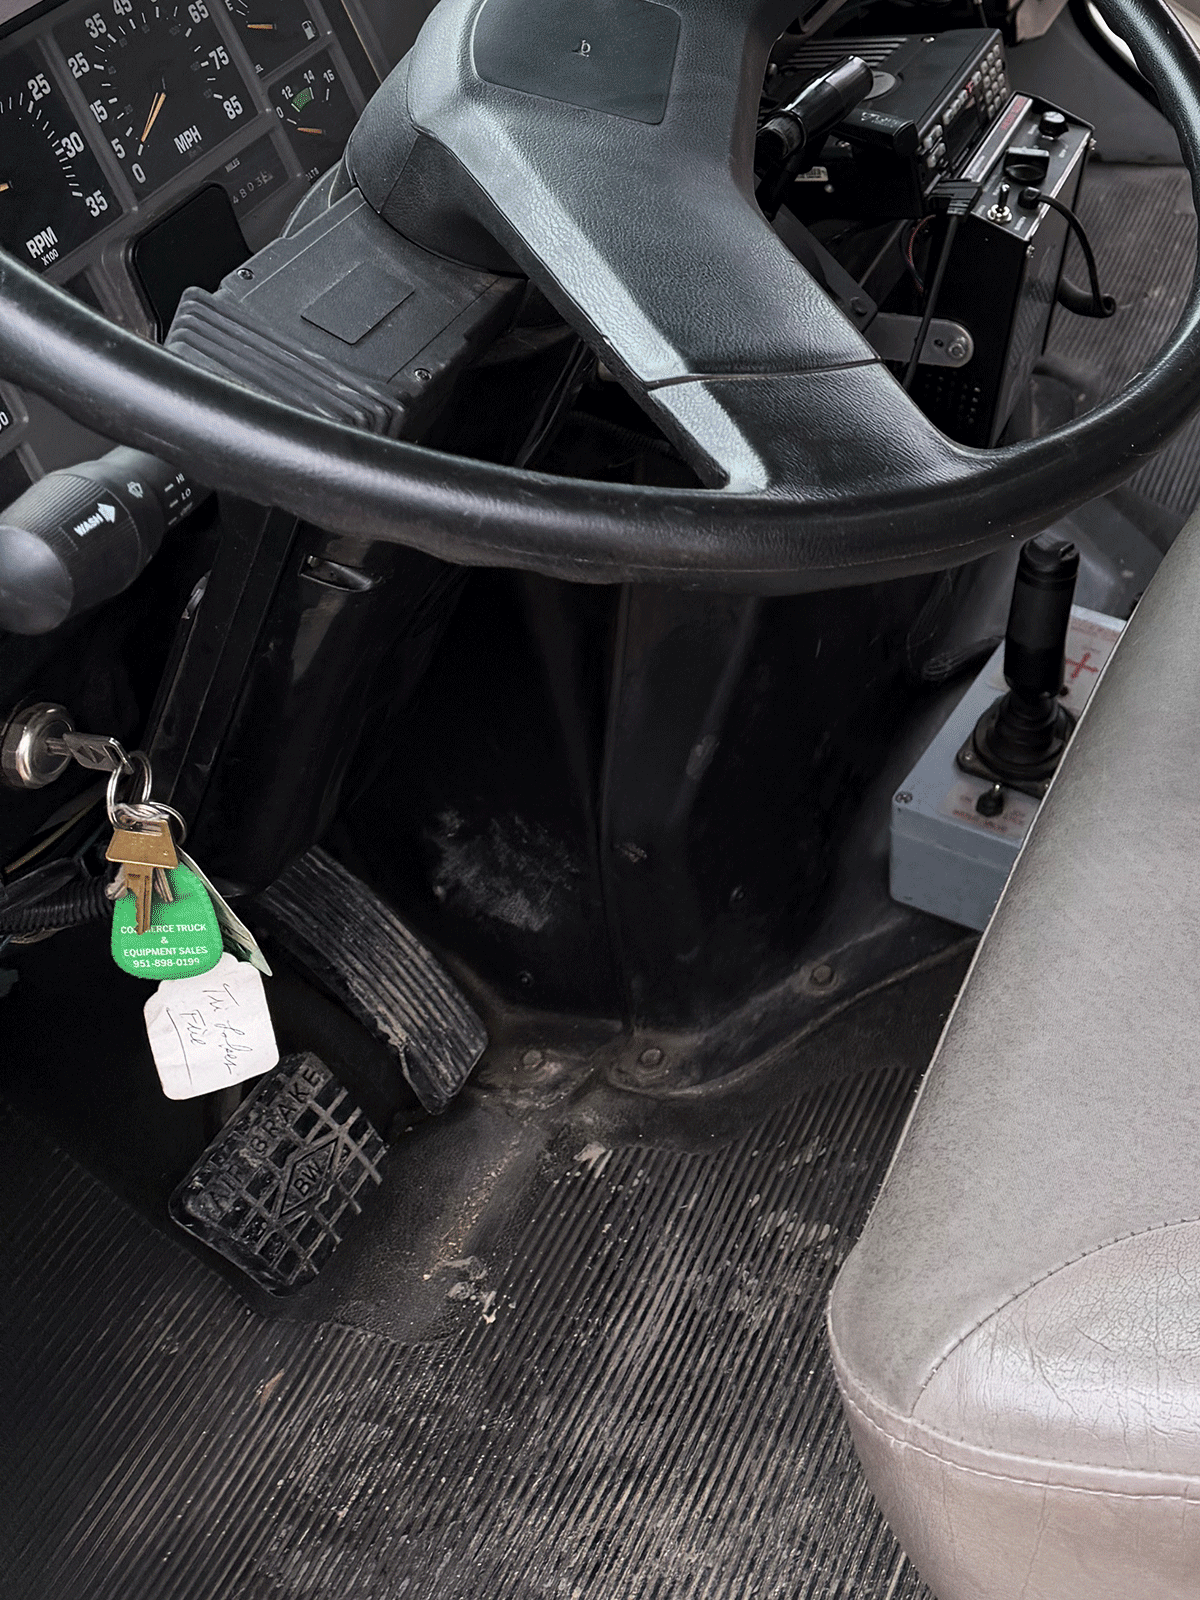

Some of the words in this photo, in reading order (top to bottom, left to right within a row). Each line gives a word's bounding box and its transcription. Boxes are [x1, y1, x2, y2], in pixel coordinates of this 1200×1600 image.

[187, 0, 209, 24] 65
[84, 12, 107, 39] 35
[67, 51, 90, 79] 25
[208, 45, 230, 70] 75
[27, 73, 52, 101] 25
[303, 69, 315, 84] 14
[322, 68, 335, 83] 16
[281, 85, 294, 100] 12
[89, 99, 108, 123] 15
[222, 95, 243, 120] 85
[275, 106, 285, 119] 0
[61, 131, 85, 159] 30
[111, 137, 126, 159] 5
[173, 125, 203, 154] MPH
[131, 163, 147, 184] 0
[85, 189, 109, 218] 35
[25, 225, 59, 259] RPM
[40, 248, 60, 266] X100
[175, 472, 185, 485] HI
[180, 487, 192, 501] LO
[73, 512, 105, 537] WASH
[120, 924, 175, 935] COERCE
[176, 923, 207, 932] TRUCK
[160, 936, 169, 944] &
[123, 947, 176, 957] EQUIPMENT
[179, 946, 208, 955] SALES
[132, 957, 200, 968] 951-898-0199
[250, 1067, 321, 1155] BRAKE
[293, 1161, 321, 1197] BW
